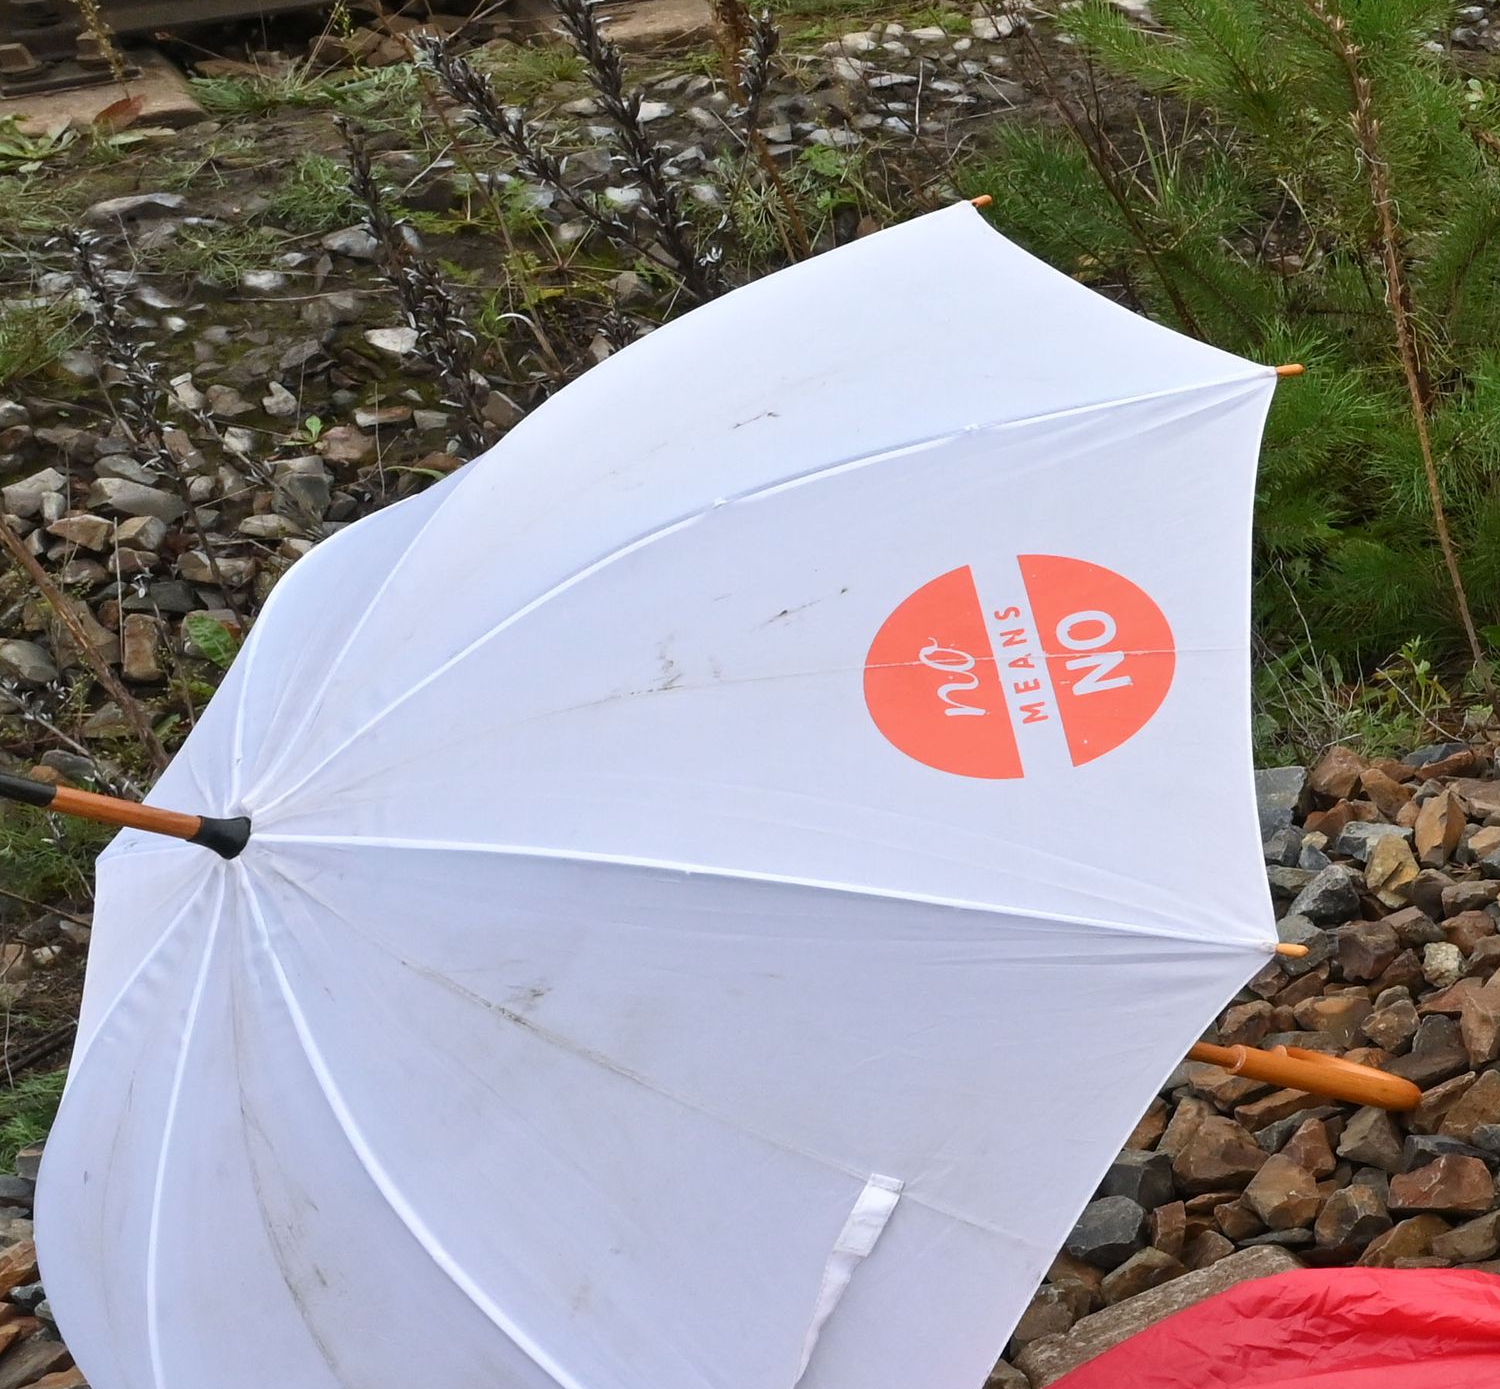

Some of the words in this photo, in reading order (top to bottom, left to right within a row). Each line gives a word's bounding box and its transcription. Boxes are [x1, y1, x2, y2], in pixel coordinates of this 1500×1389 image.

[919, 636, 987, 717] no
[994, 606, 1049, 724] MEANS
[1056, 610, 1132, 697] NO
